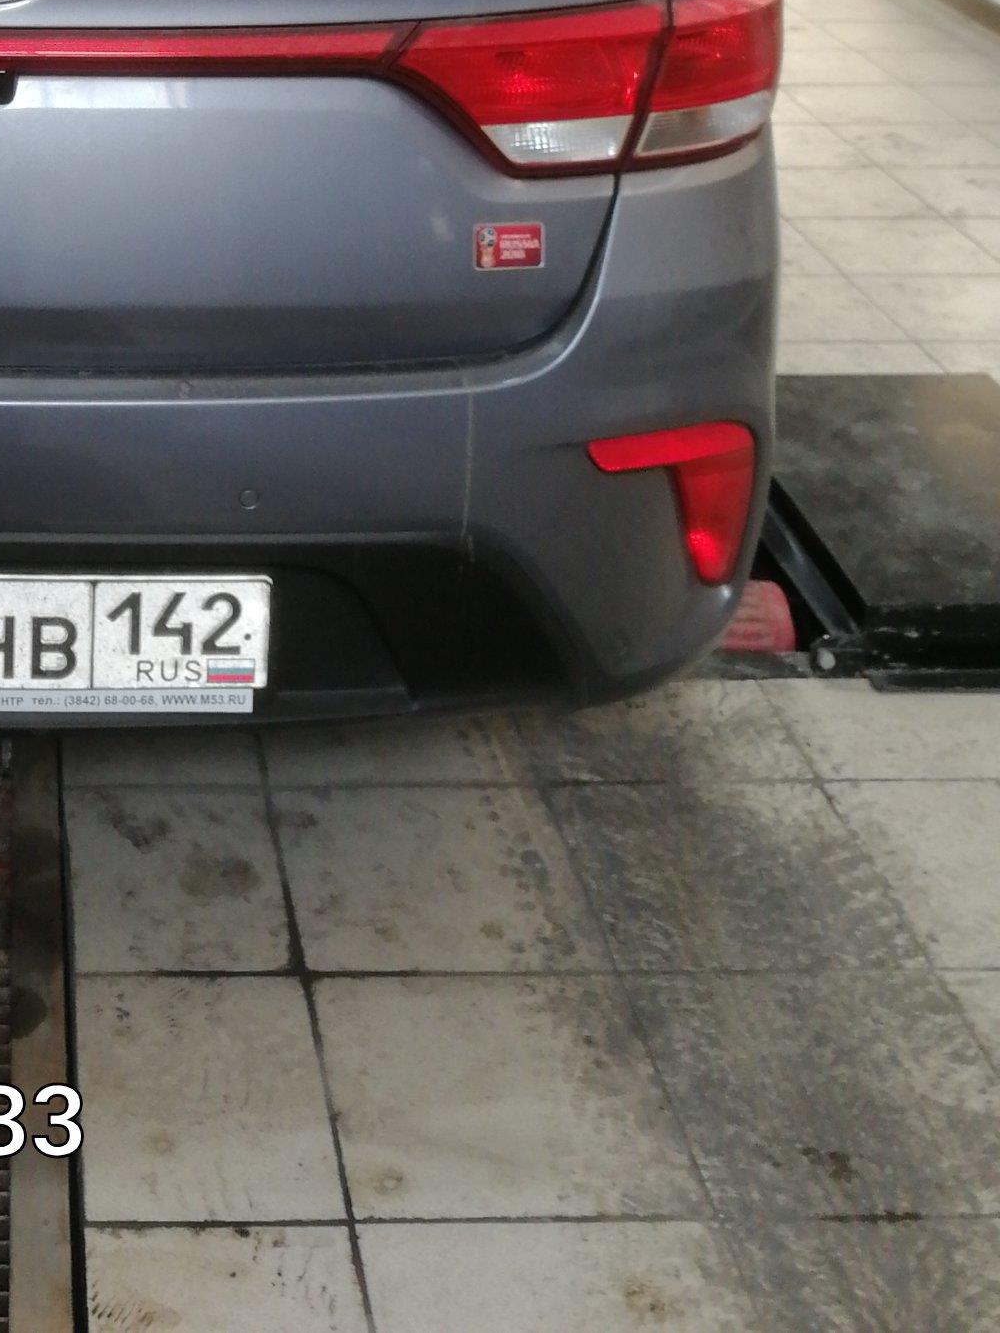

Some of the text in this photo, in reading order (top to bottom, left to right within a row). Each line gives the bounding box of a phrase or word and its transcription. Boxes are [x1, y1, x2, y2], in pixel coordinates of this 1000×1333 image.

[106, 591, 242, 656] 142
[136, 660, 202, 683] RUS
[63, 695, 100, 708] (3842)
[161, 694, 247, 706] WWW.M53.RU
